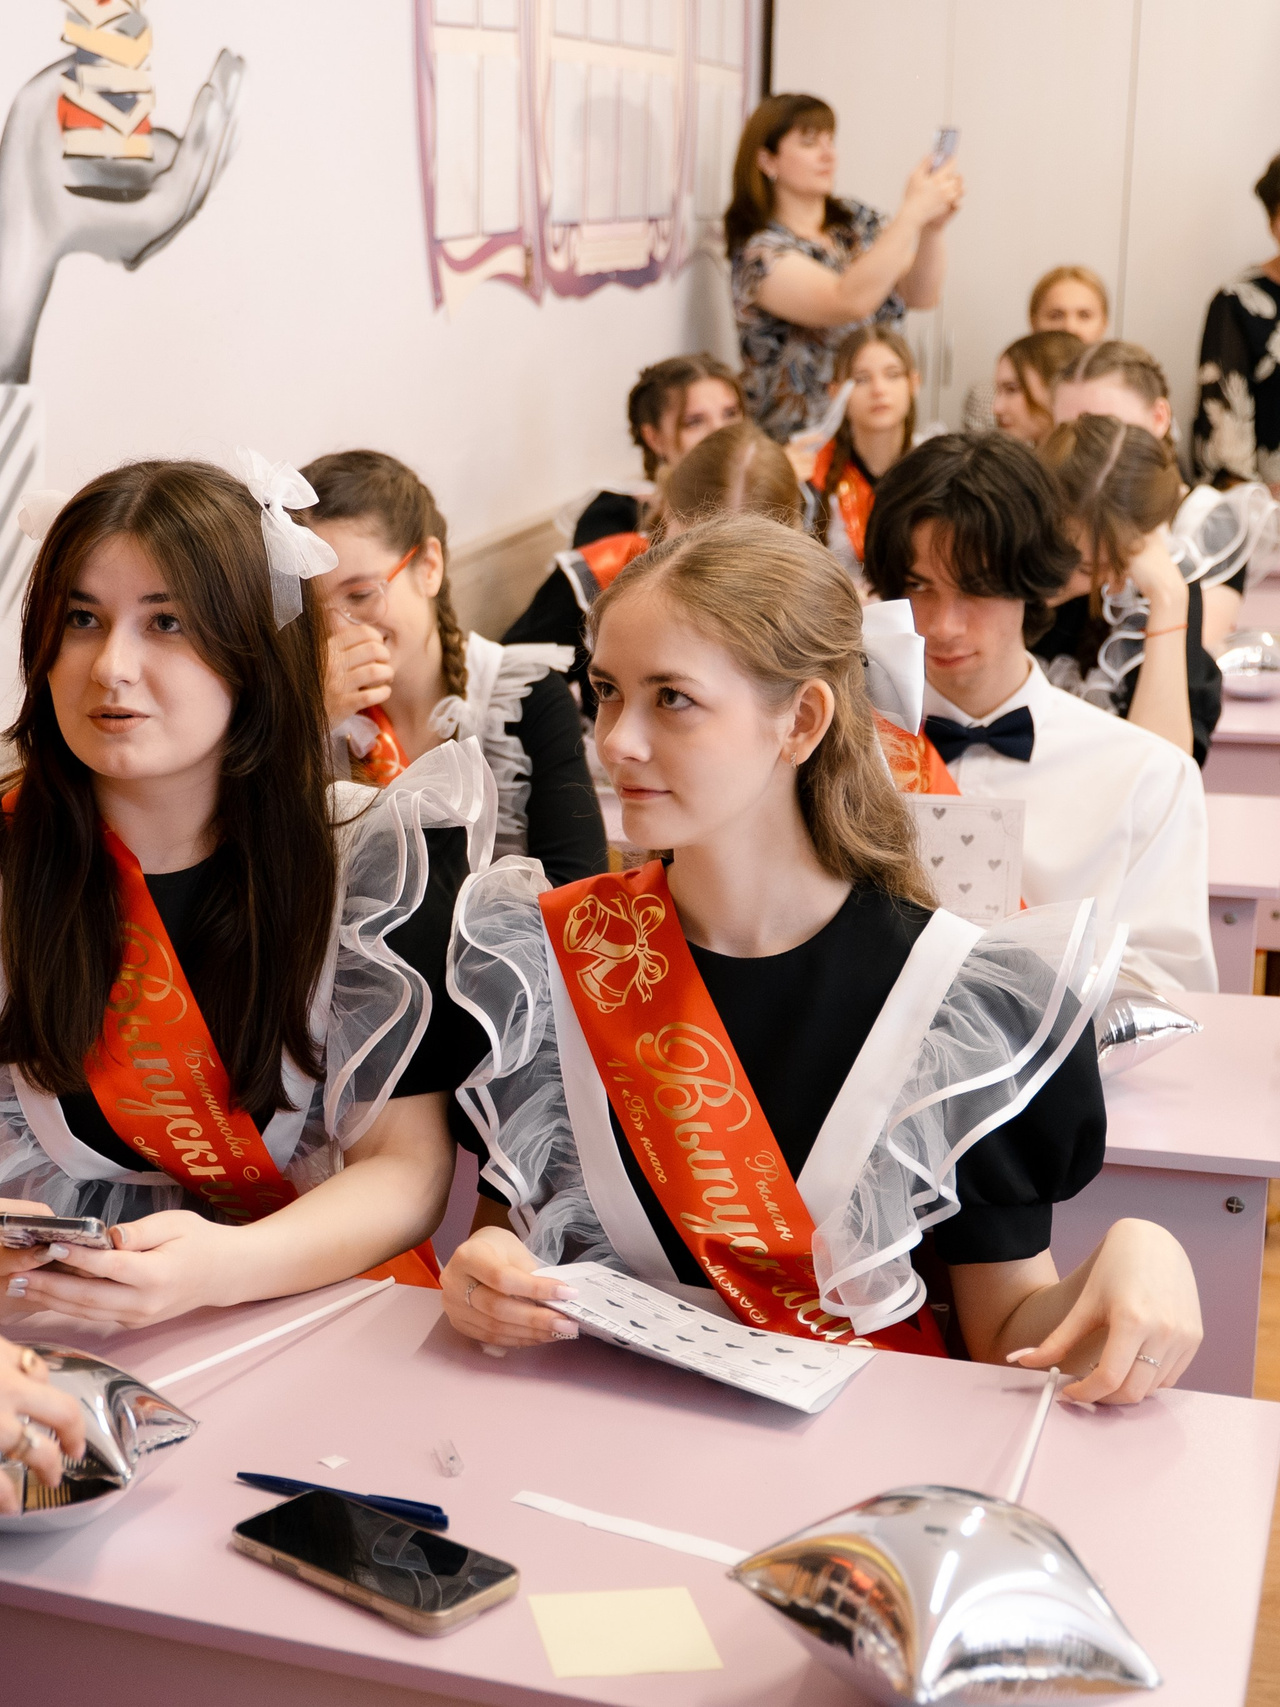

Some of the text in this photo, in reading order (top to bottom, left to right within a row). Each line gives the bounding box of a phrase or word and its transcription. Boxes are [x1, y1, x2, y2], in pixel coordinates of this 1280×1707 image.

[178, 1037, 251, 1158] Банникова
[640, 1136, 667, 1184] класс
[744, 1150, 794, 1241] Рыман
